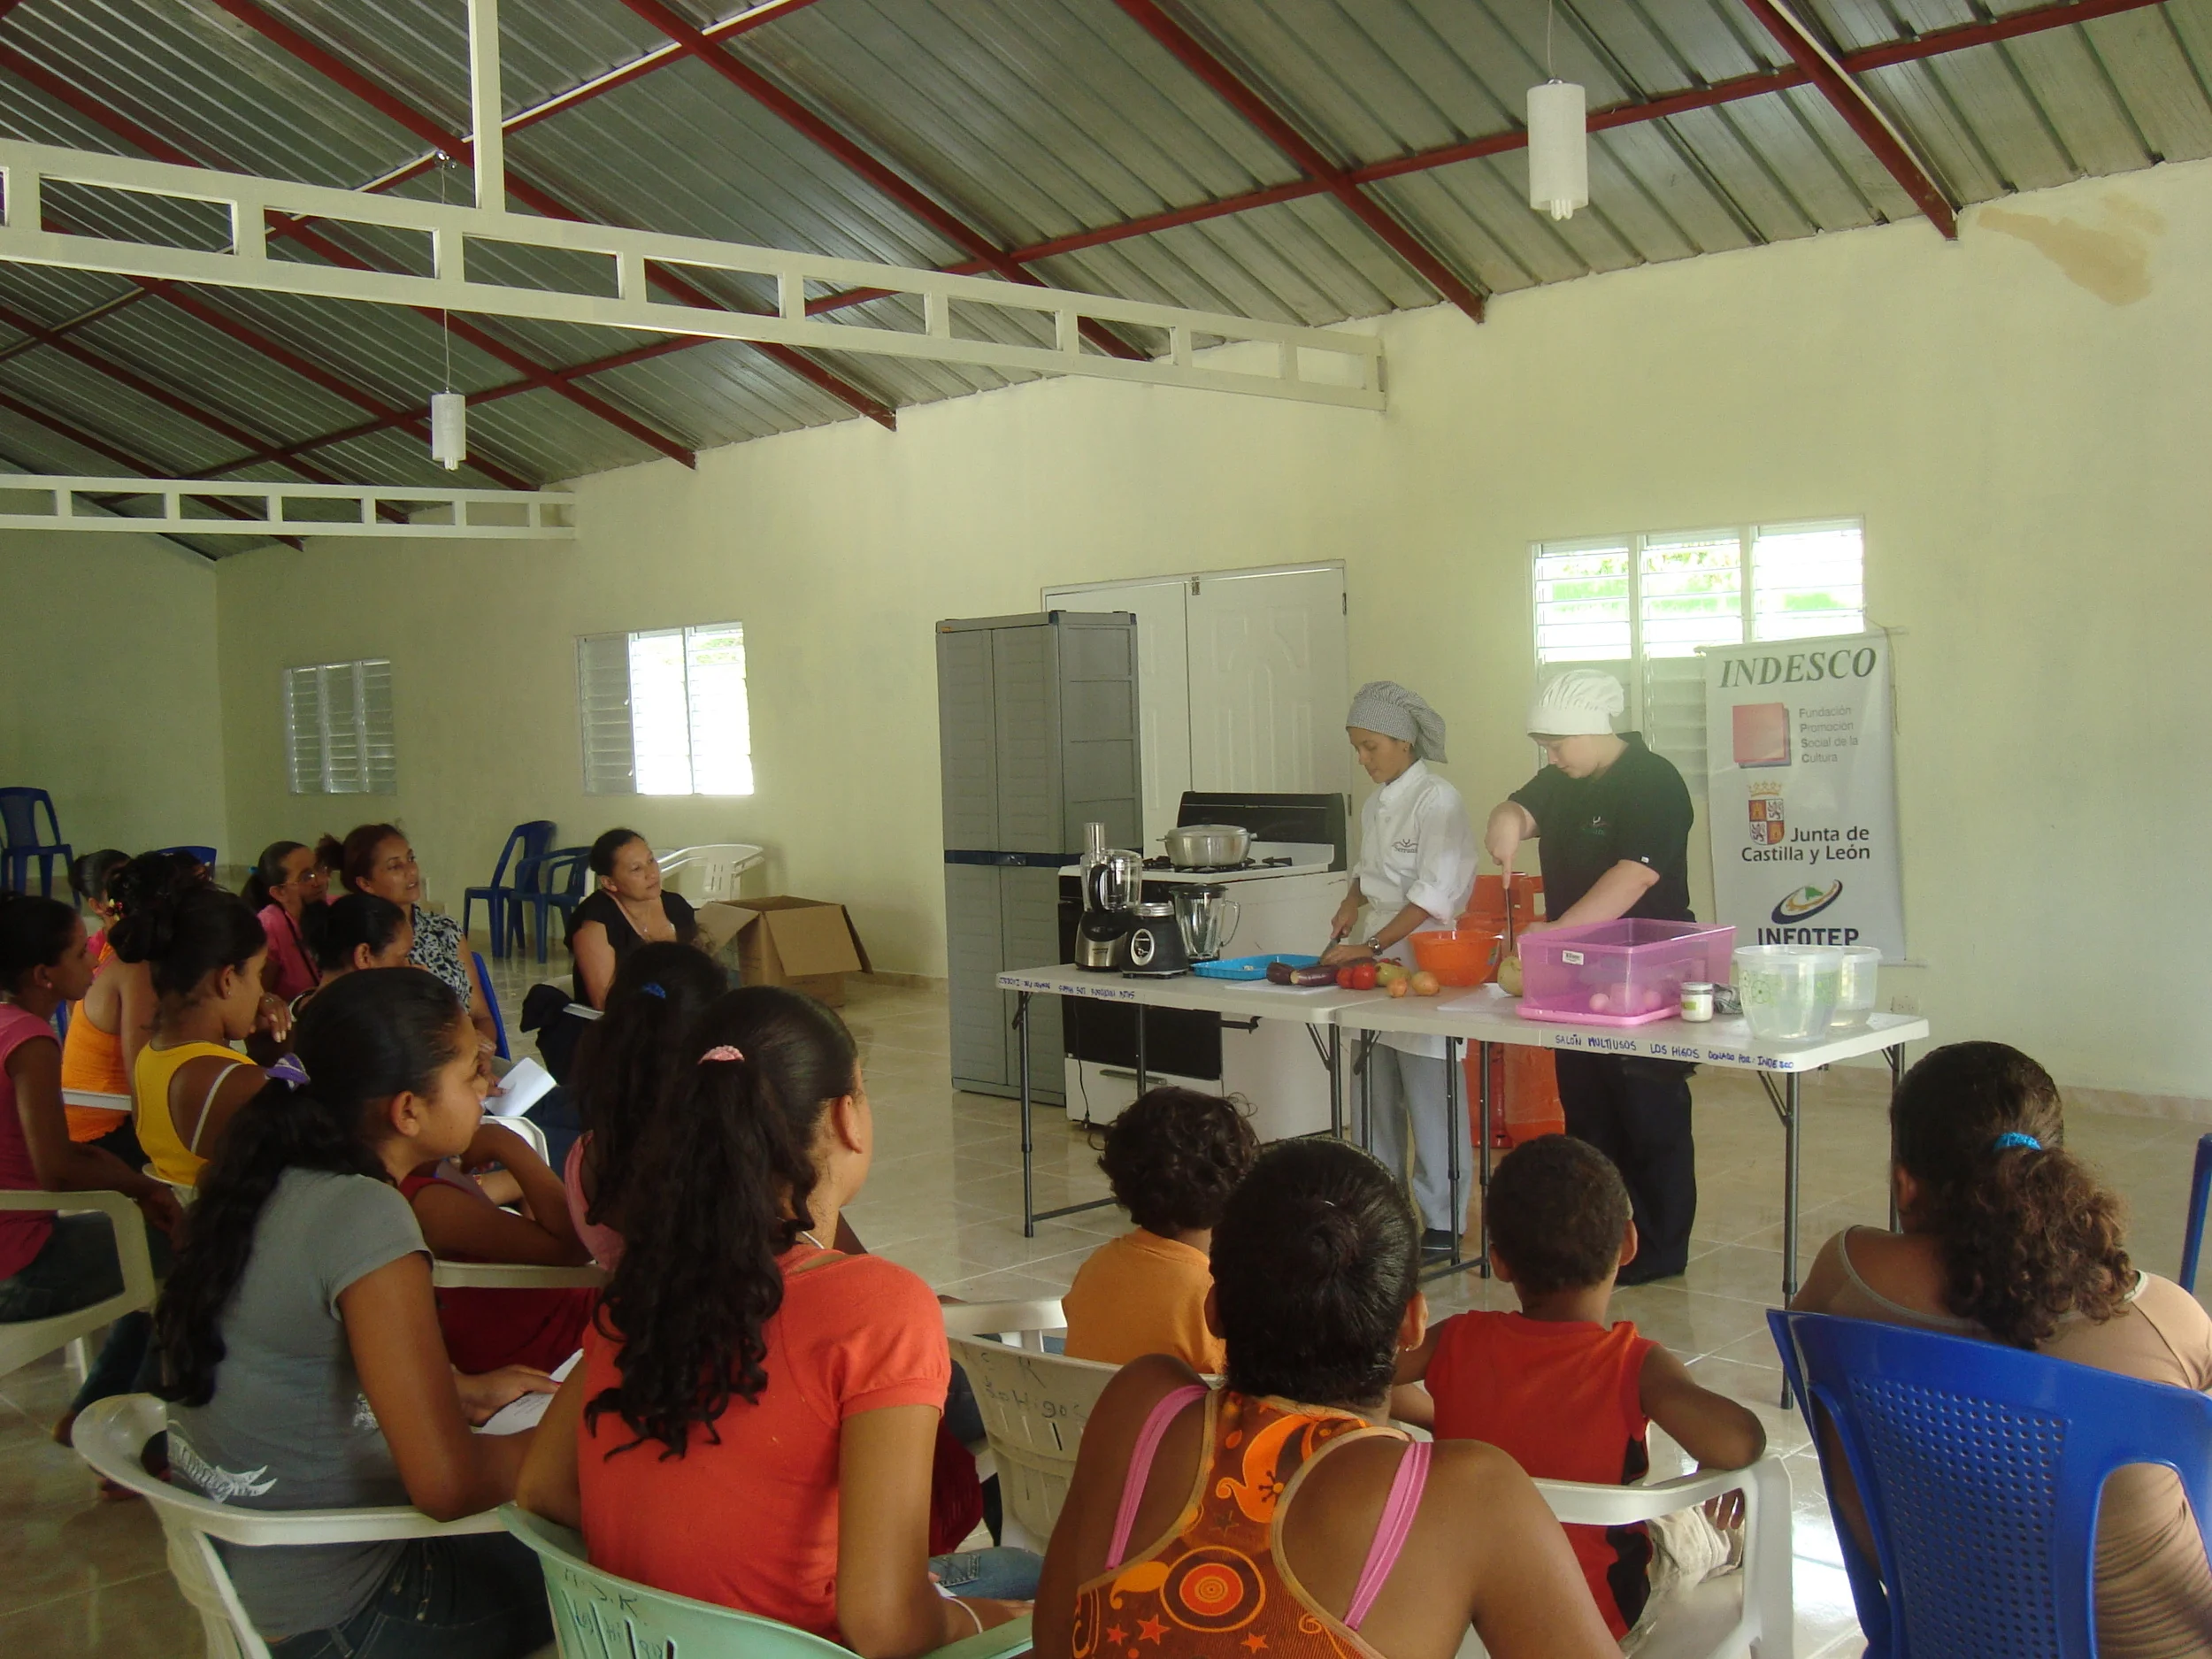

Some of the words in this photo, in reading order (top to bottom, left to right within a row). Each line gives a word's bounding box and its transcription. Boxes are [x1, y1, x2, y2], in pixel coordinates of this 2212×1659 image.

[1718, 647, 1877, 688] INDESCO
[1799, 705, 1852, 718] Fundación
[1800, 720, 1855, 733] Promoción
[1801, 735, 1832, 749] Social
[1833, 735, 1847, 747] de
[1849, 734, 1859, 746] la
[1801, 751, 1839, 764] Cultura
[1790, 826, 1839, 843] Junta
[1846, 826, 1870, 841] de
[1741, 846, 1804, 862] Castilla
[1809, 849, 1820, 864] y
[1825, 844, 1870, 861] León
[1757, 927, 1859, 946] INFOTEP
[1587, 1036, 1637, 1051] MULTIUSOS
[1649, 1043, 1668, 1055] LOS
[1708, 1049, 1735, 1061] DONADO
